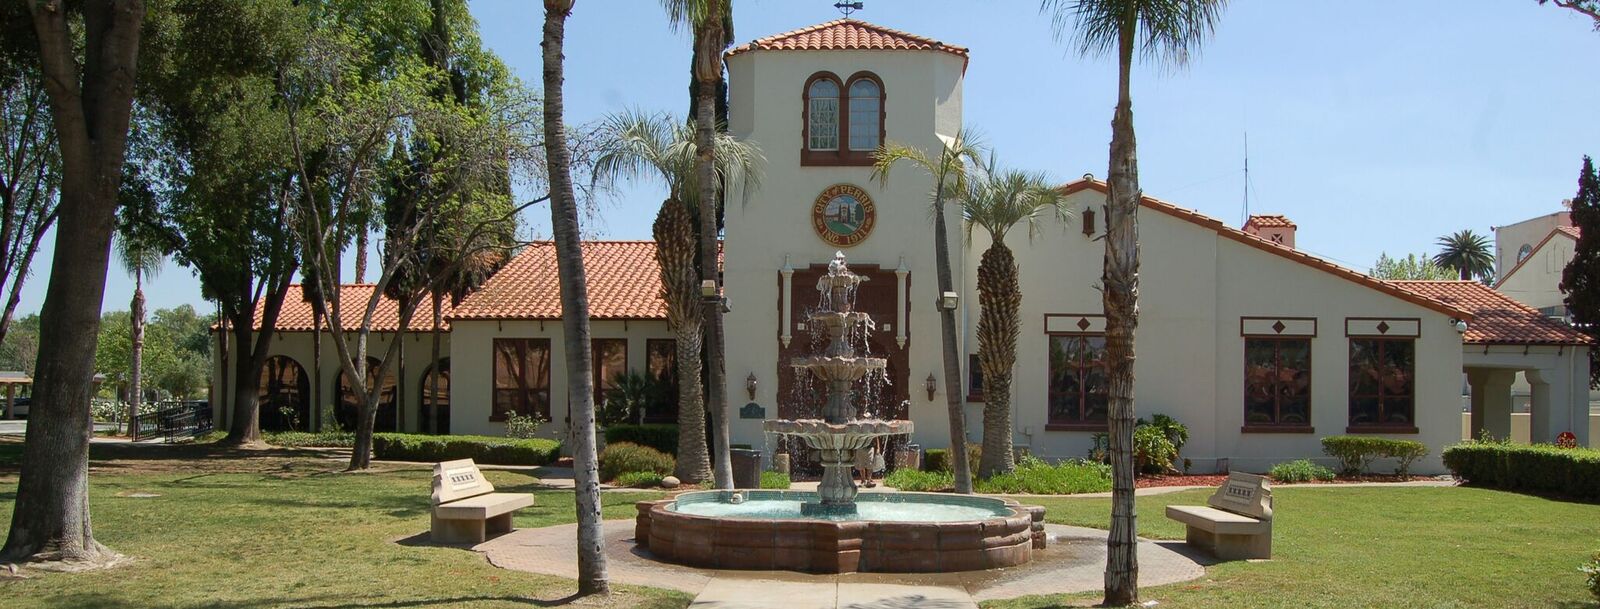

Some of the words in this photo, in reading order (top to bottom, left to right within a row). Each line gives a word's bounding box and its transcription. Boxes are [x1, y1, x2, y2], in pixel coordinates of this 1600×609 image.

[815, 191, 832, 213] CITY
[840, 186, 873, 213] PERRIS
[847, 229, 867, 244] 1911
